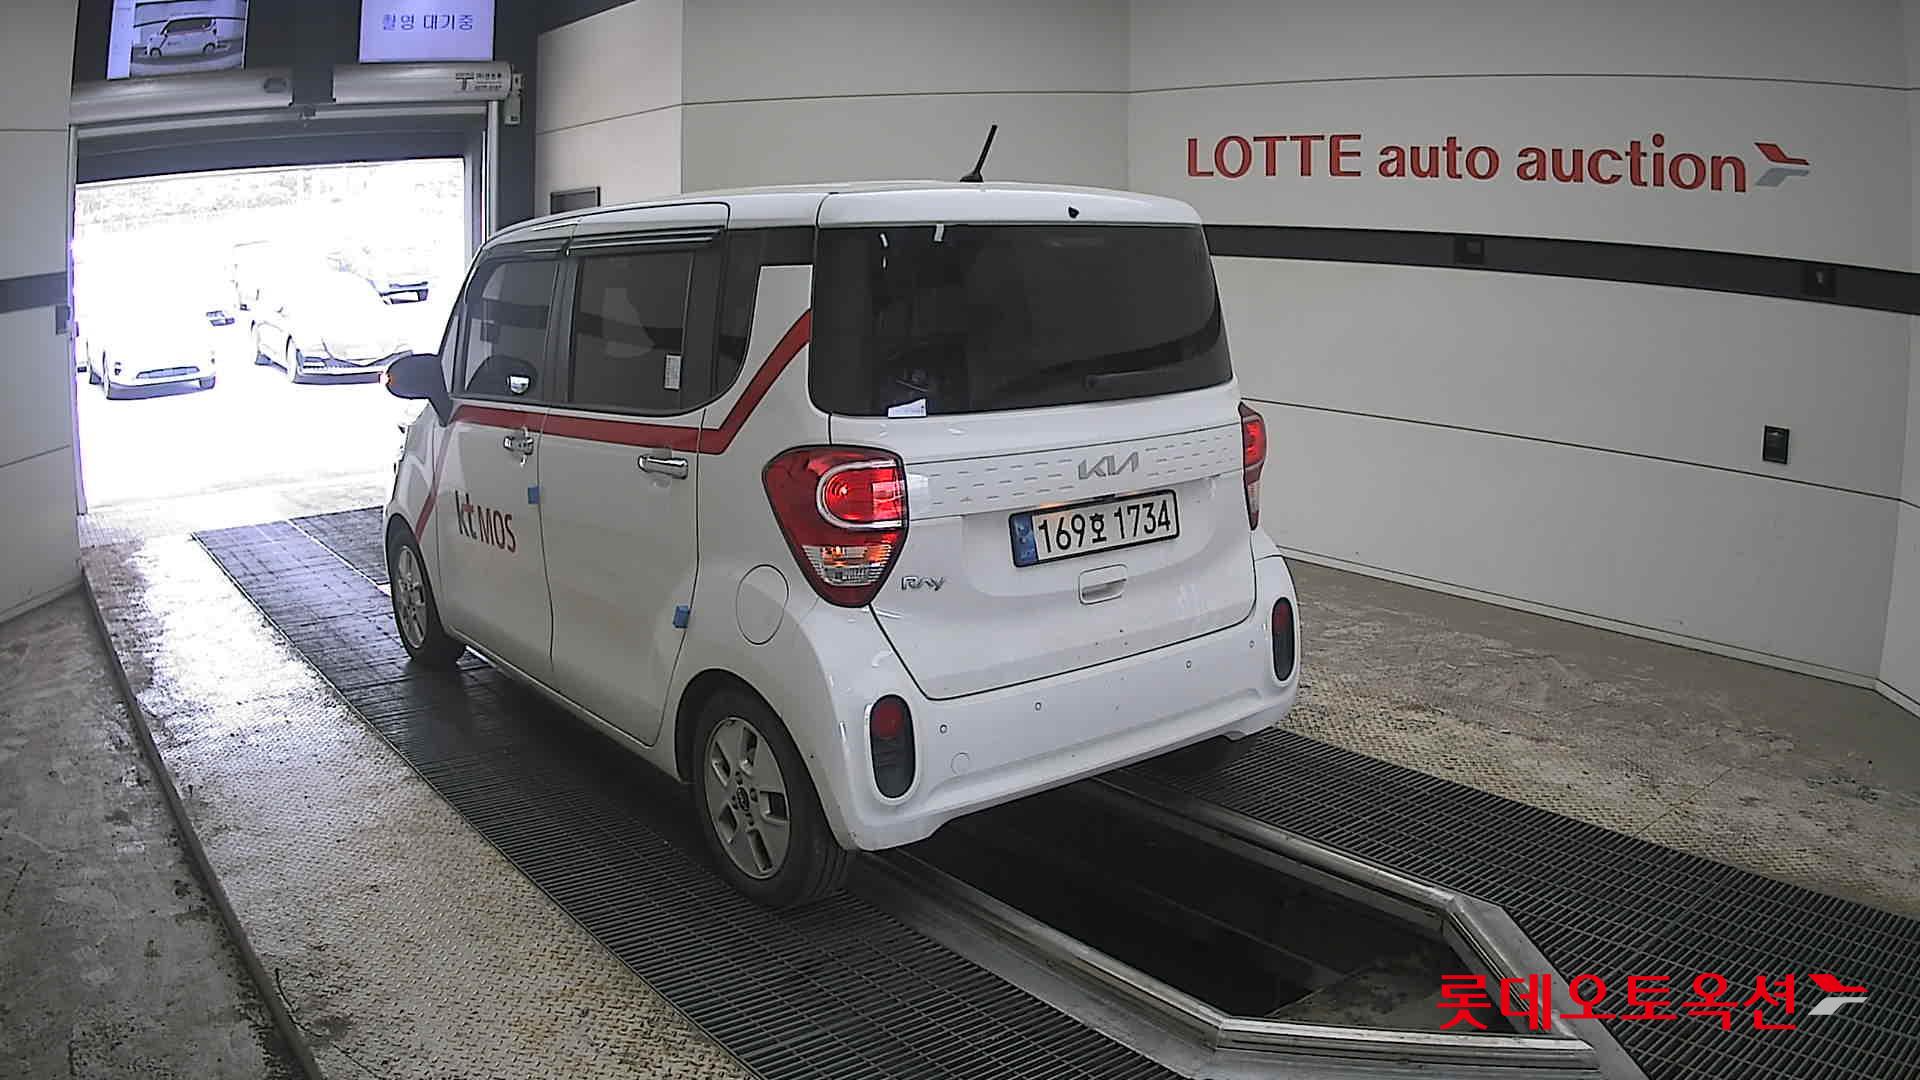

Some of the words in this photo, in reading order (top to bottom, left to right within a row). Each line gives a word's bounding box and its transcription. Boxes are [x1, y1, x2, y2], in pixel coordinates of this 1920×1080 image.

[423, 14, 473, 31] 대기중
[1187, 133, 1361, 180] LOTTE
[1378, 136, 1501, 180] auto
[1516, 133, 1746, 192] auction
[1078, 452, 1139, 480] KIA
[455, 490, 477, 540] kt
[477, 505, 516, 552] MOS
[1038, 513, 1107, 553] 169호
[1114, 500, 1171, 539] 1734
